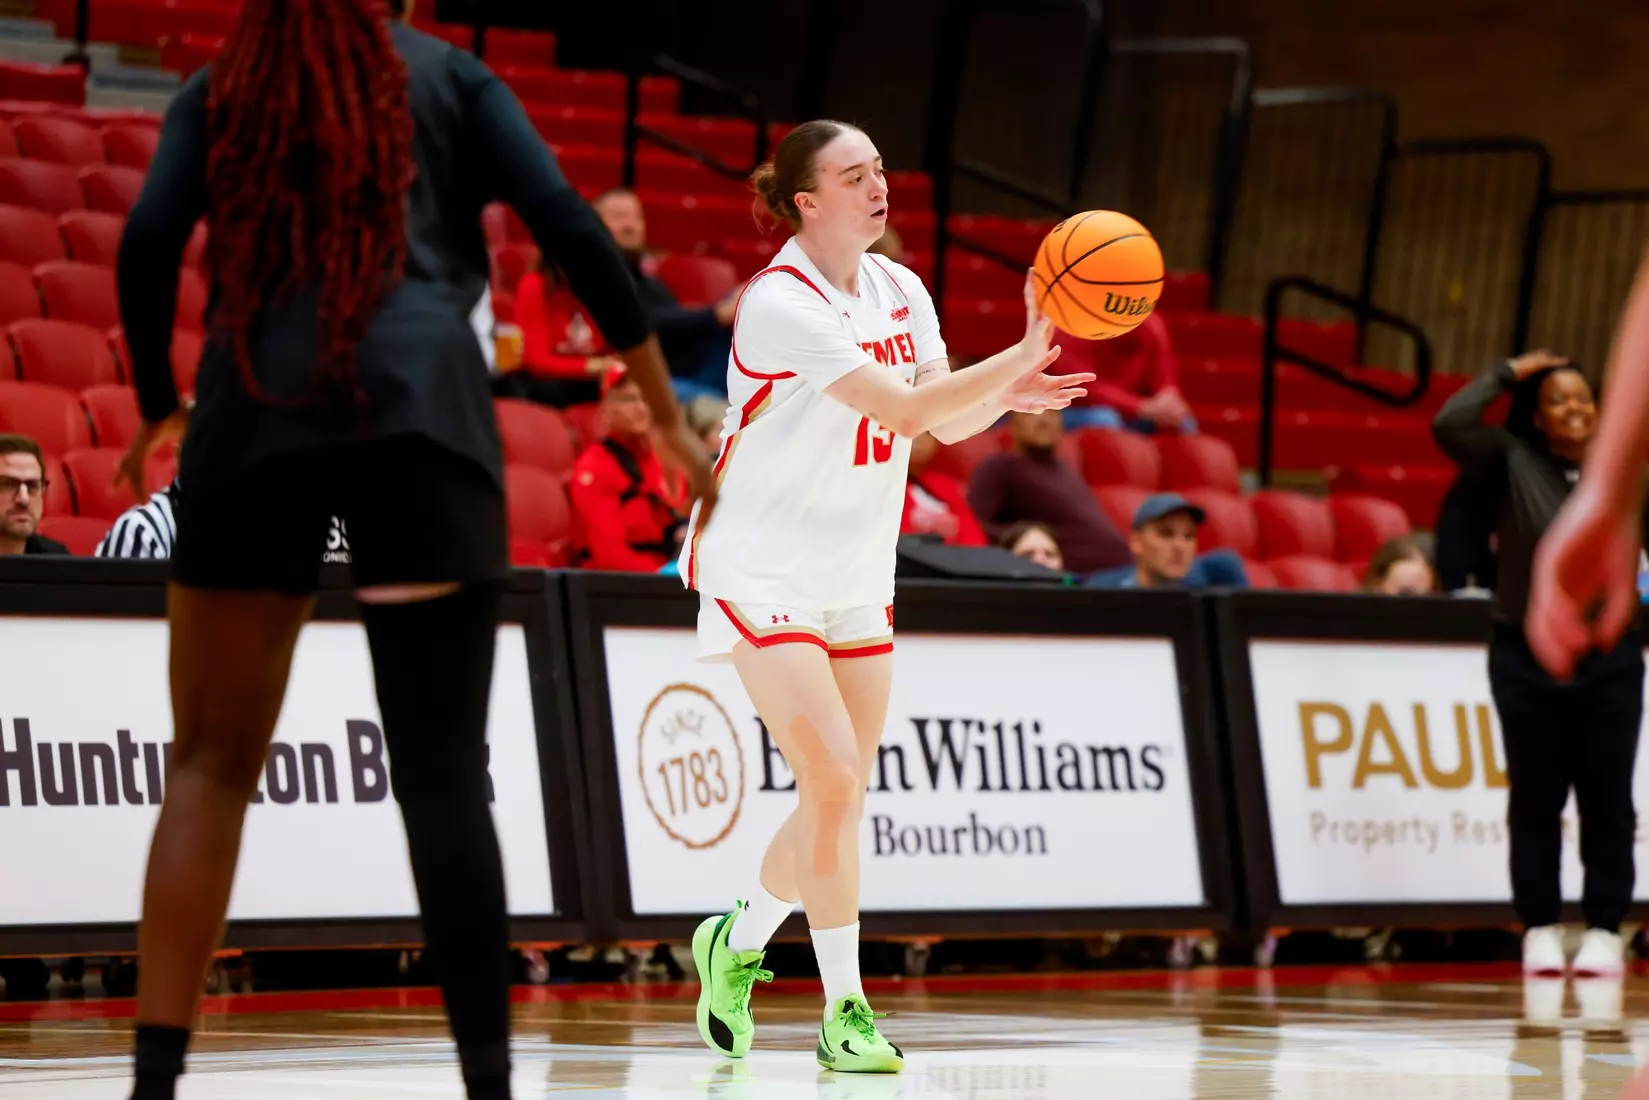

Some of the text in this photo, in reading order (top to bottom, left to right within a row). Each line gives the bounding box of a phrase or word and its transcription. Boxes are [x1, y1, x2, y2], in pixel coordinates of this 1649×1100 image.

[0, 717, 339, 806] Huntion
[1298, 701, 1510, 790] PAUL
[656, 747, 728, 816] 1783
[871, 811, 1049, 857] Bourbon
[1309, 811, 1440, 854] Property
